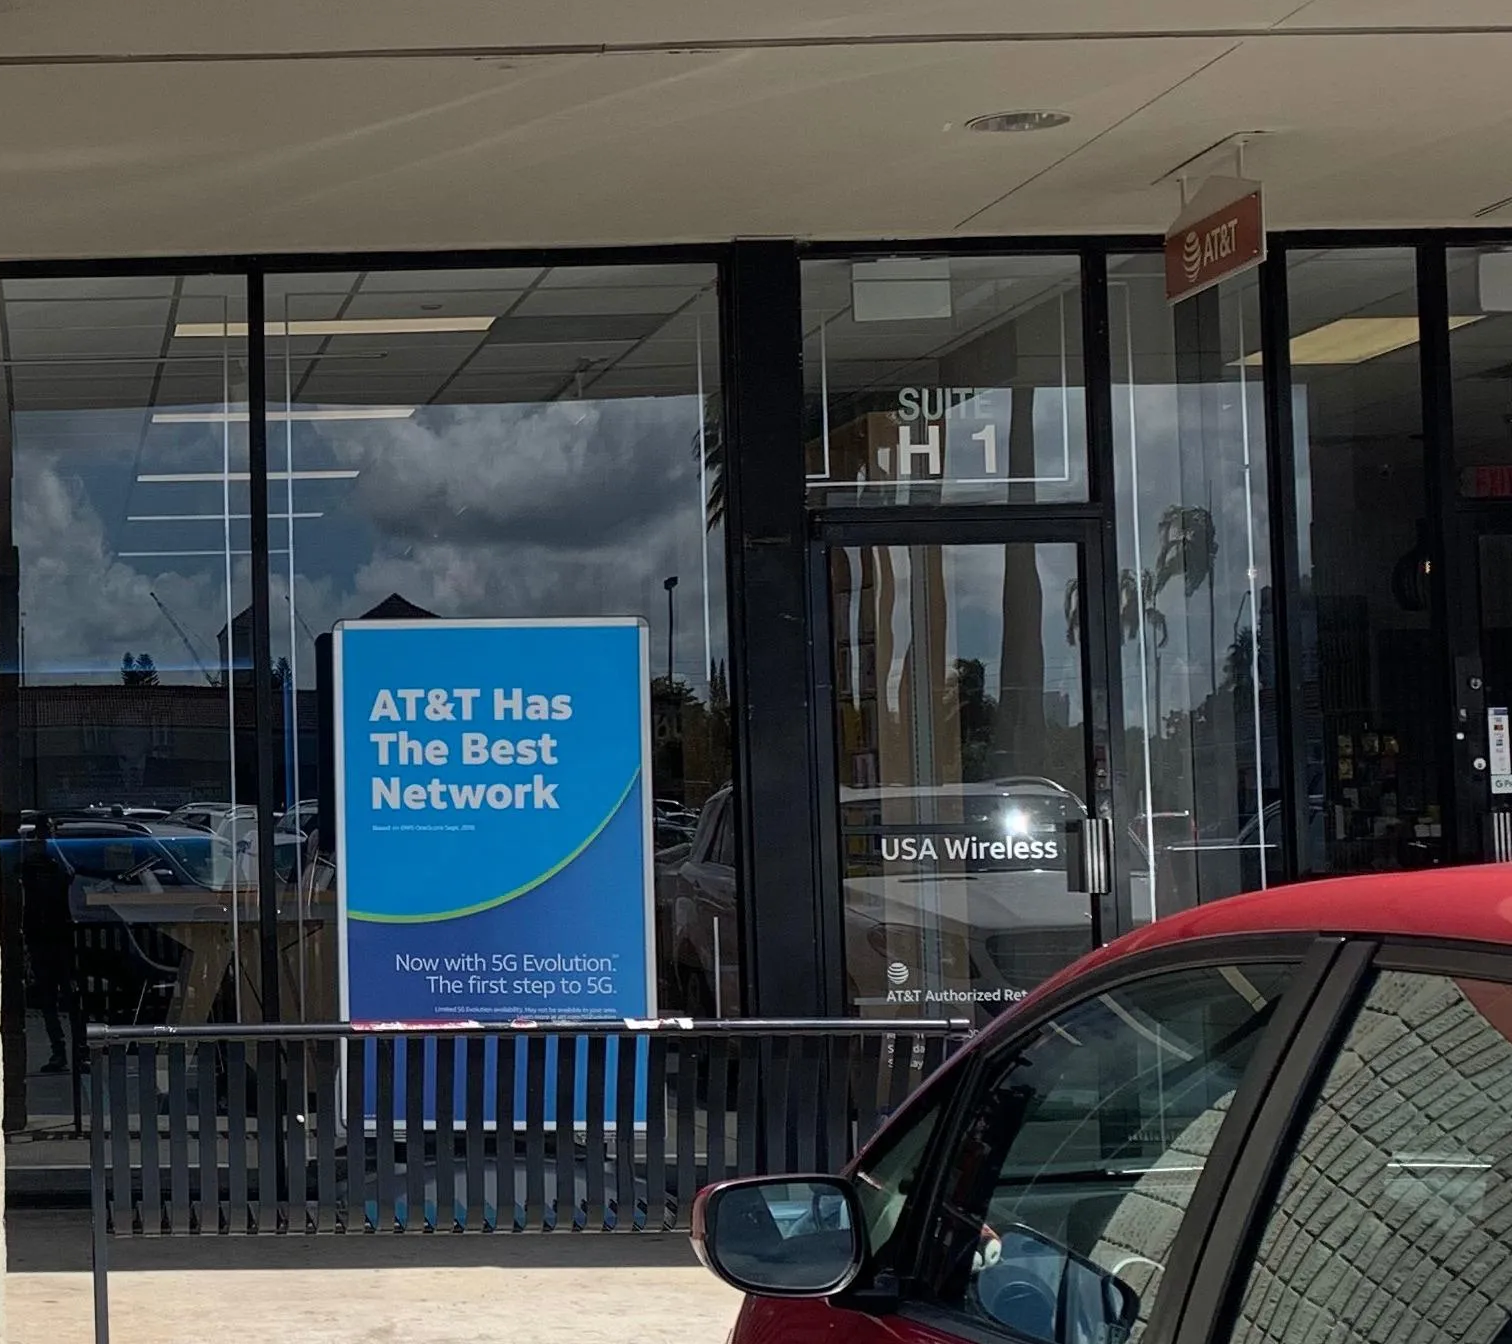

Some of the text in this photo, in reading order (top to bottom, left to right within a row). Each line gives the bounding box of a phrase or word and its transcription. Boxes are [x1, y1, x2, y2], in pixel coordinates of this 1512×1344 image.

[1203, 218, 1239, 268] AT&T
[898, 387, 994, 421] SUITE
[899, 424, 997, 475] H 1
[369, 687, 573, 721] AT&T Has
[369, 730, 559, 766] The Best
[371, 774, 560, 810] Network
[881, 836, 1058, 861] USA Wireless
[395, 954, 439, 972] Now
[444, 953, 486, 972] with
[491, 954, 517, 972] 5G
[426, 975, 617, 998] The first step to 5G.
[886, 989, 922, 1002] AT&T
[925, 988, 1001, 1002] Authorized
